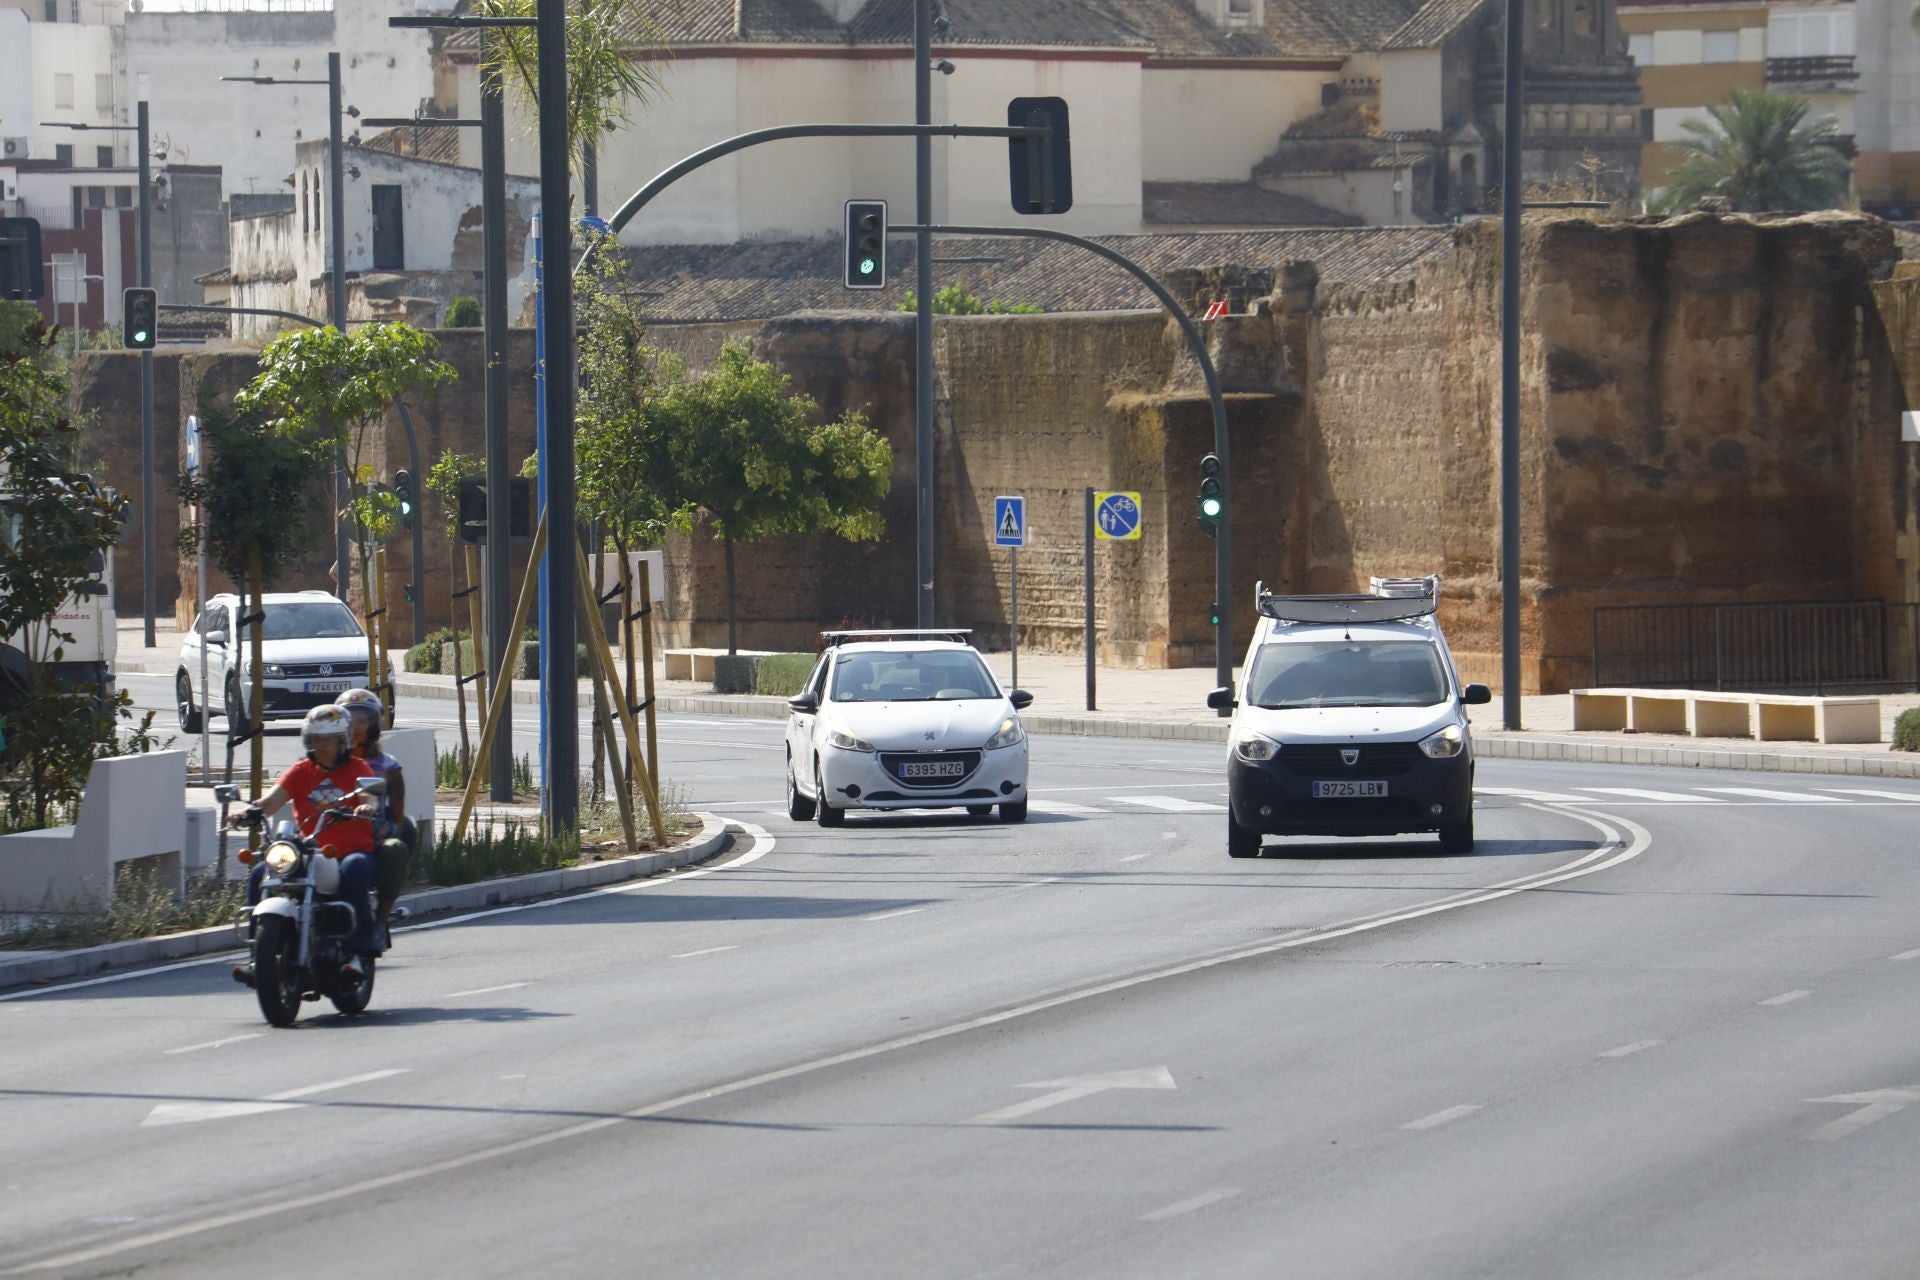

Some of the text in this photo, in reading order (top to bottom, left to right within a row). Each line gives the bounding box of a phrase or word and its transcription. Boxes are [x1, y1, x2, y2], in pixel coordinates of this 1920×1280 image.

[907, 763, 962, 776] 6395 HZG
[1322, 782, 1384, 796] 9725 LBW
